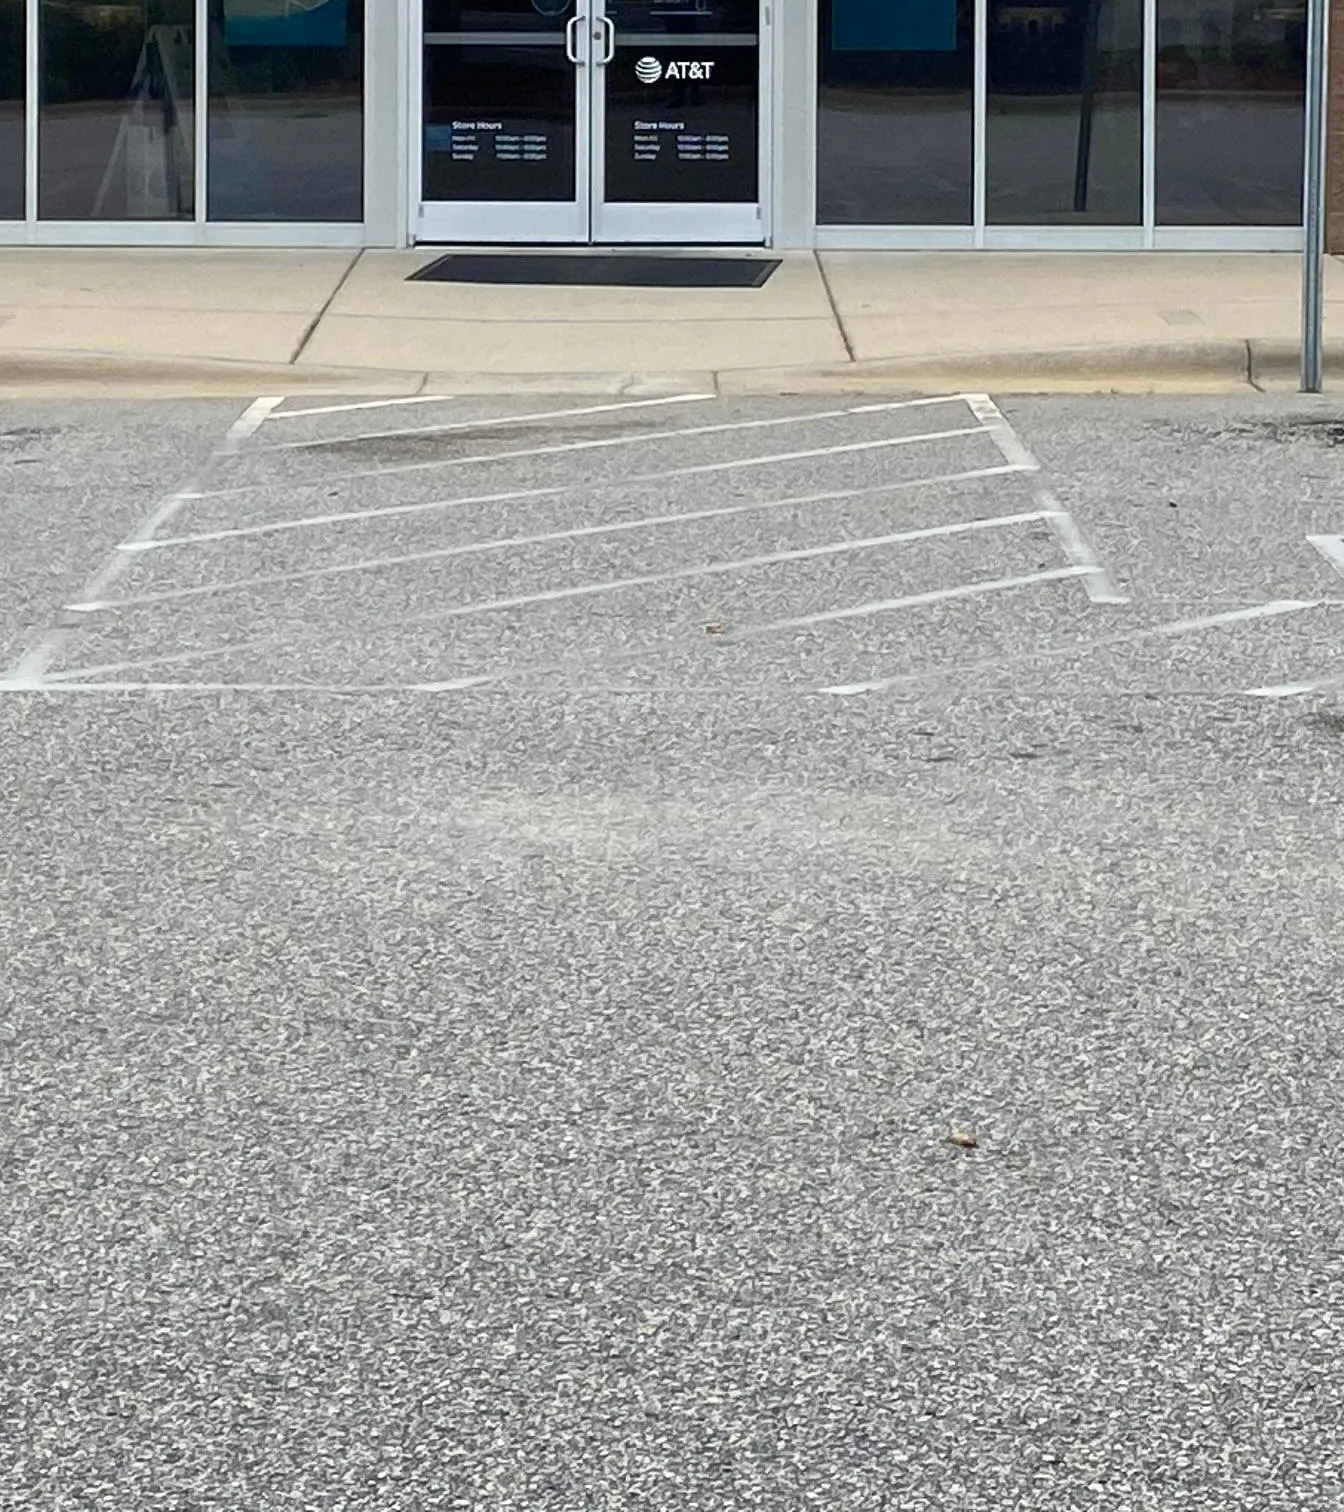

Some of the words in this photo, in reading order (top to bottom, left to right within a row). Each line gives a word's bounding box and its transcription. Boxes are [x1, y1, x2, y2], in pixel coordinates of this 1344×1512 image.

[665, 61, 715, 80] AT&T
[452, 121, 476, 130] Store
[477, 121, 503, 130] Hours
[634, 121, 658, 130] Store
[659, 121, 685, 130] Hours
